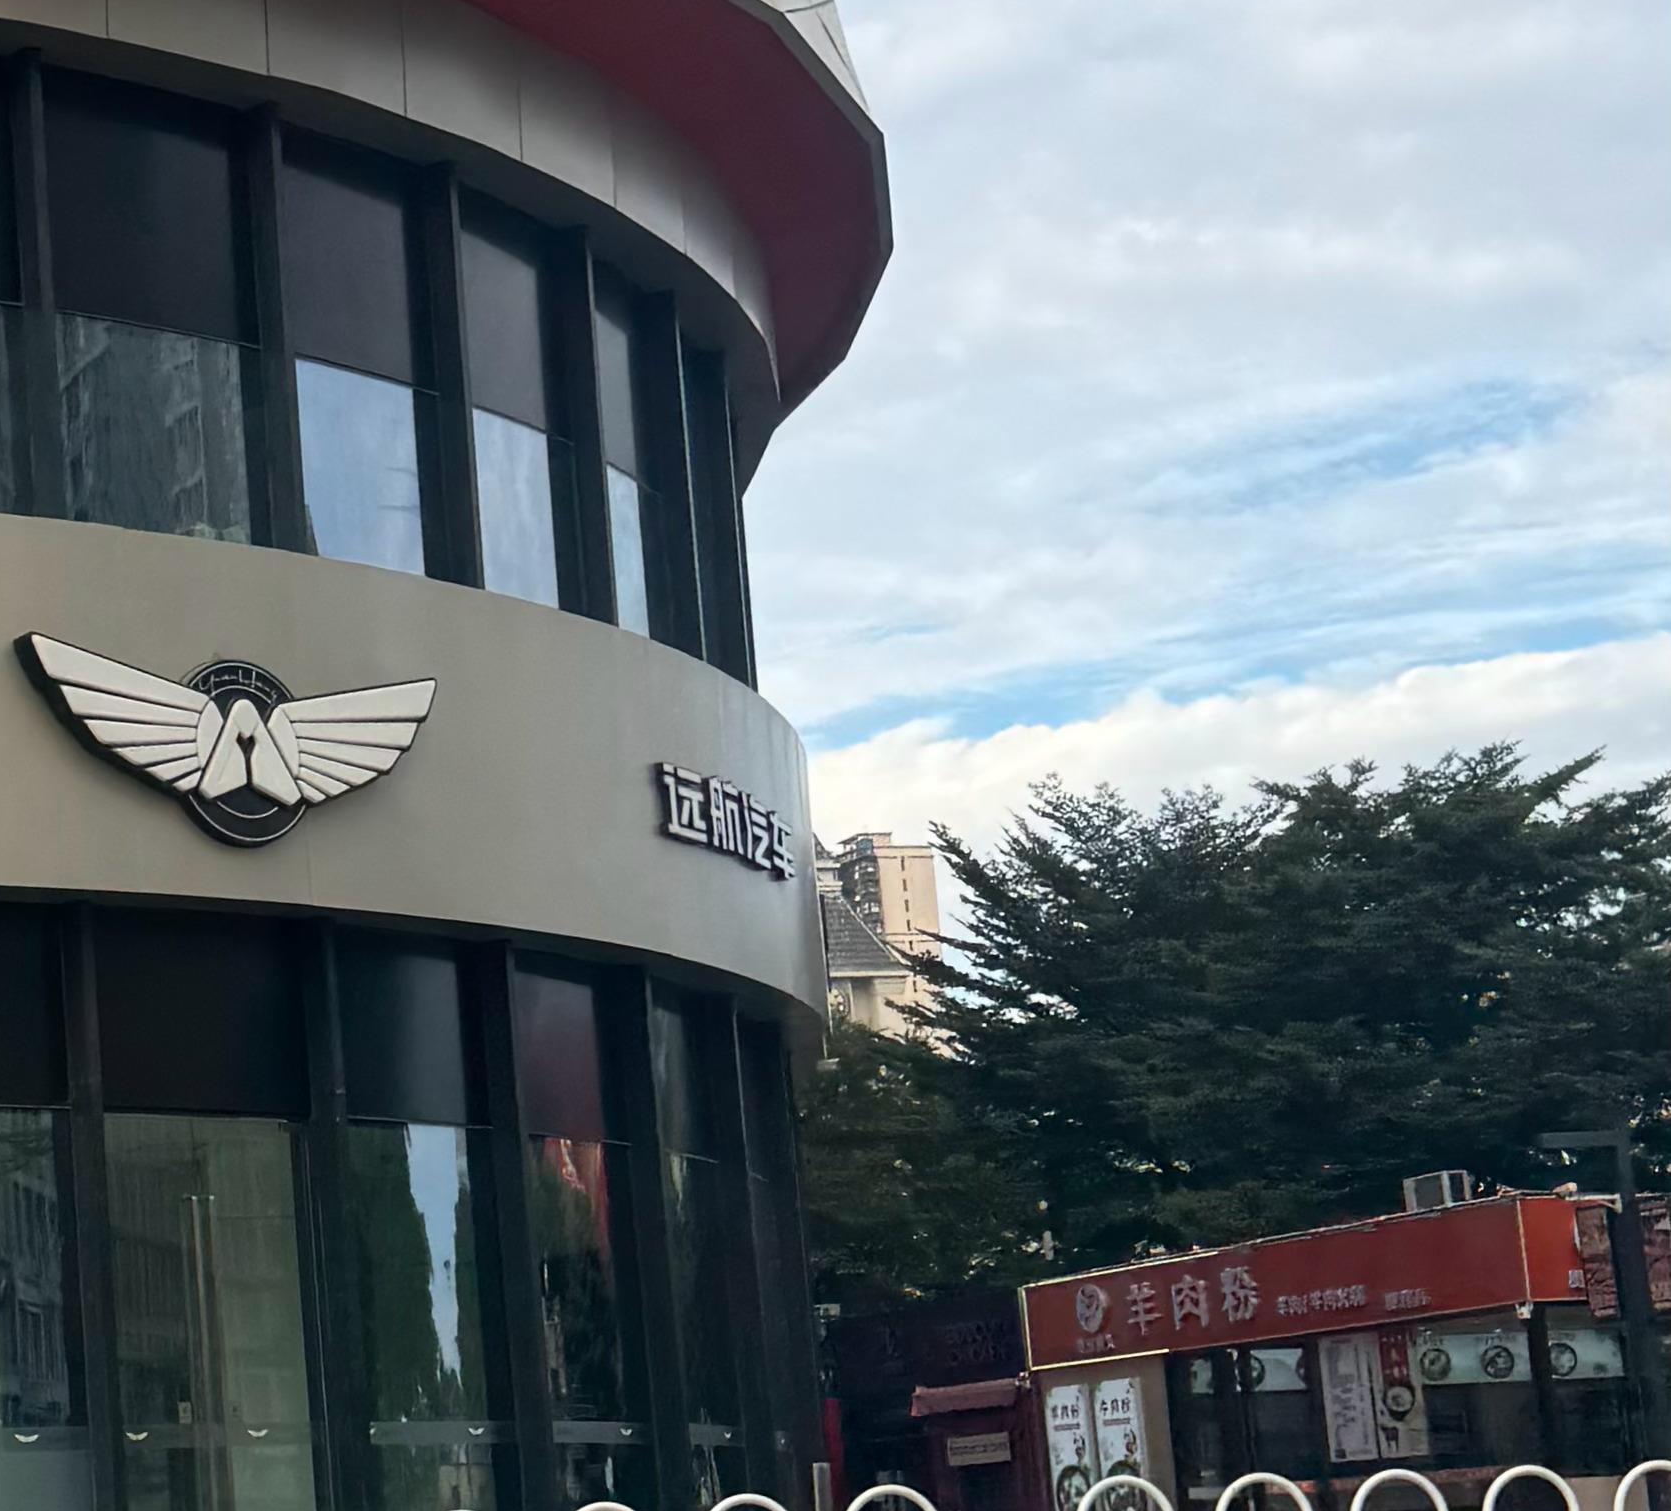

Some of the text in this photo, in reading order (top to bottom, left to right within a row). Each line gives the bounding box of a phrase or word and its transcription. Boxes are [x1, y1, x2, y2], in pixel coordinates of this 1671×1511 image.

[655, 762, 795, 880] 远航汽车
[1126, 1266, 1259, 1336] 羊肉粉
